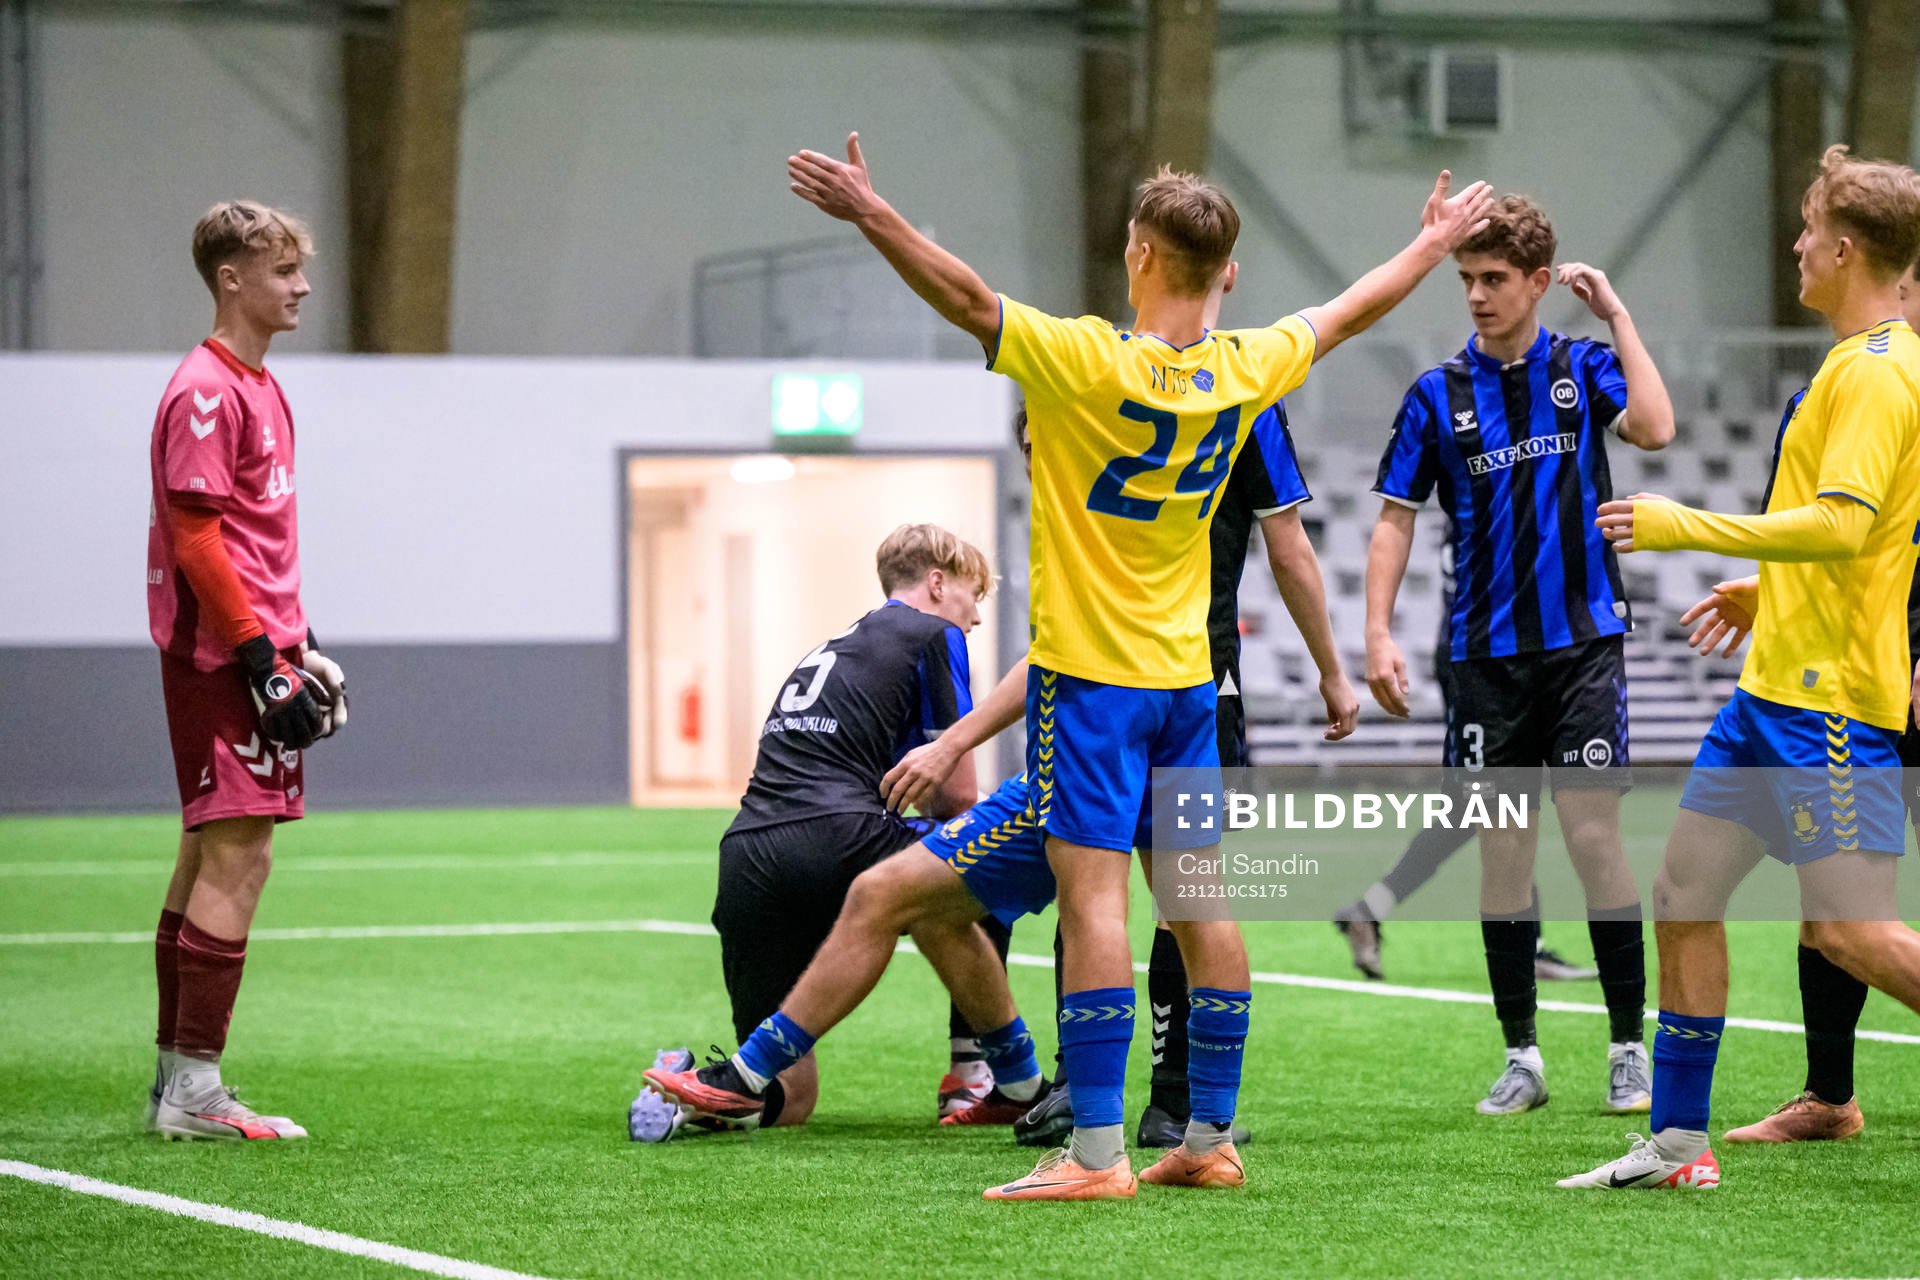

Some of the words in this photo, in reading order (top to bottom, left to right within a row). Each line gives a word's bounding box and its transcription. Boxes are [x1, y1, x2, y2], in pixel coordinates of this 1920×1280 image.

[1151, 364, 1187, 395] NTG
[1556, 387, 1574, 399] OB
[1086, 397, 1241, 521] 24
[780, 622, 859, 712] 5
[1462, 723, 1485, 773] 3
[1563, 749, 1578, 763] U17
[1589, 748, 1607, 760] OB
